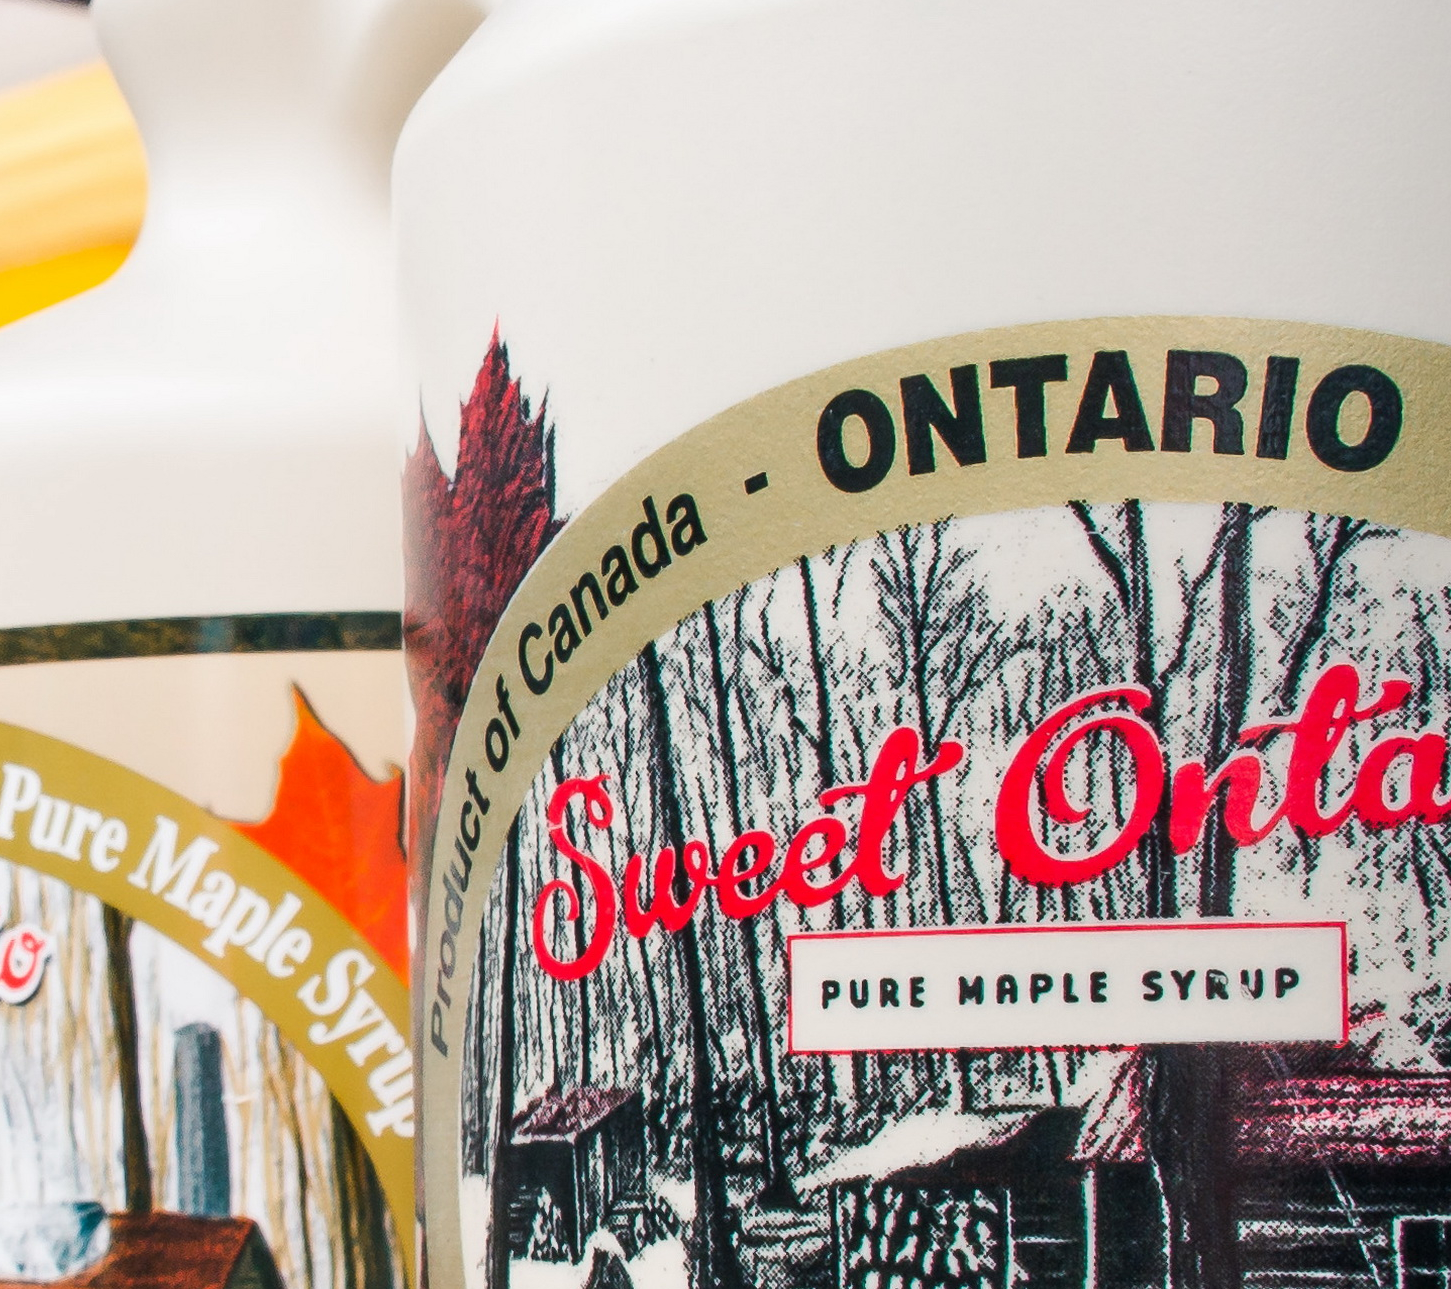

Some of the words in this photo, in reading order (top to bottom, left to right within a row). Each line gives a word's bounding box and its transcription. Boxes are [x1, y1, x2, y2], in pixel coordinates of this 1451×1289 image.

[430, 766, 491, 1058] Product
[486, 673, 525, 773] of
[518, 487, 709, 697] Canada
[816, 348, 1404, 495] ONTARIO
[127, 814, 313, 978] Maple
[532, 726, 966, 981] Sweet
[821, 975, 926, 1010] PURE
[957, 970, 1110, 1006] MAPLE
[1141, 967, 1301, 1004] SYRUP
